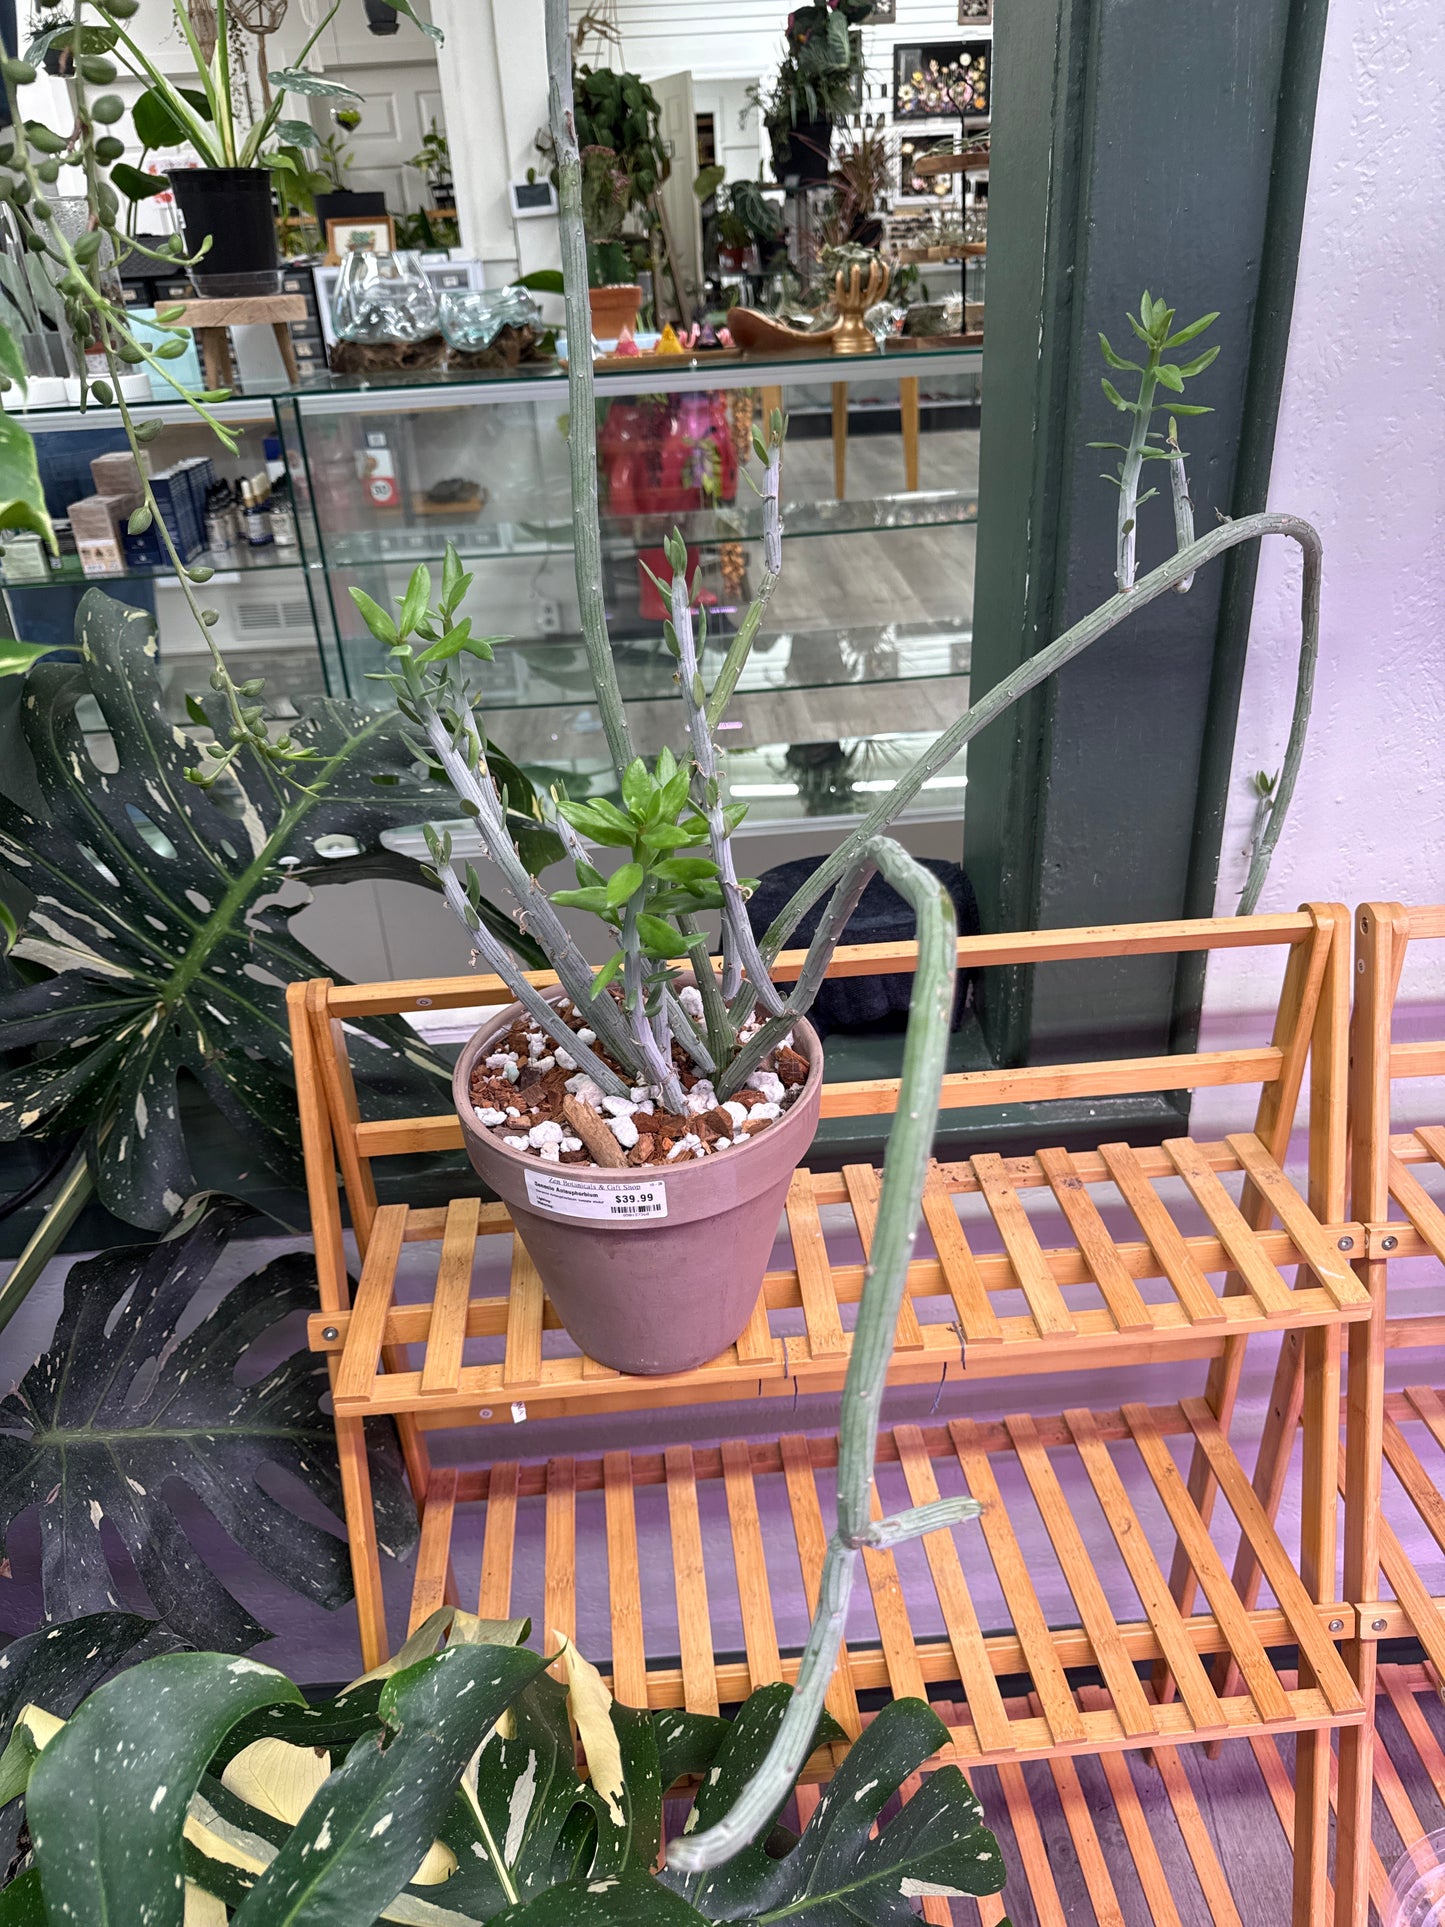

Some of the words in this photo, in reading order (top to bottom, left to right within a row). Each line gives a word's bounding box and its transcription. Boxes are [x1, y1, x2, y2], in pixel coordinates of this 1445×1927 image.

[548, 1177, 561, 1185] Zen
[562, 1180, 597, 1190] Botanicals
[615, 1193, 654, 1203] $39.99
